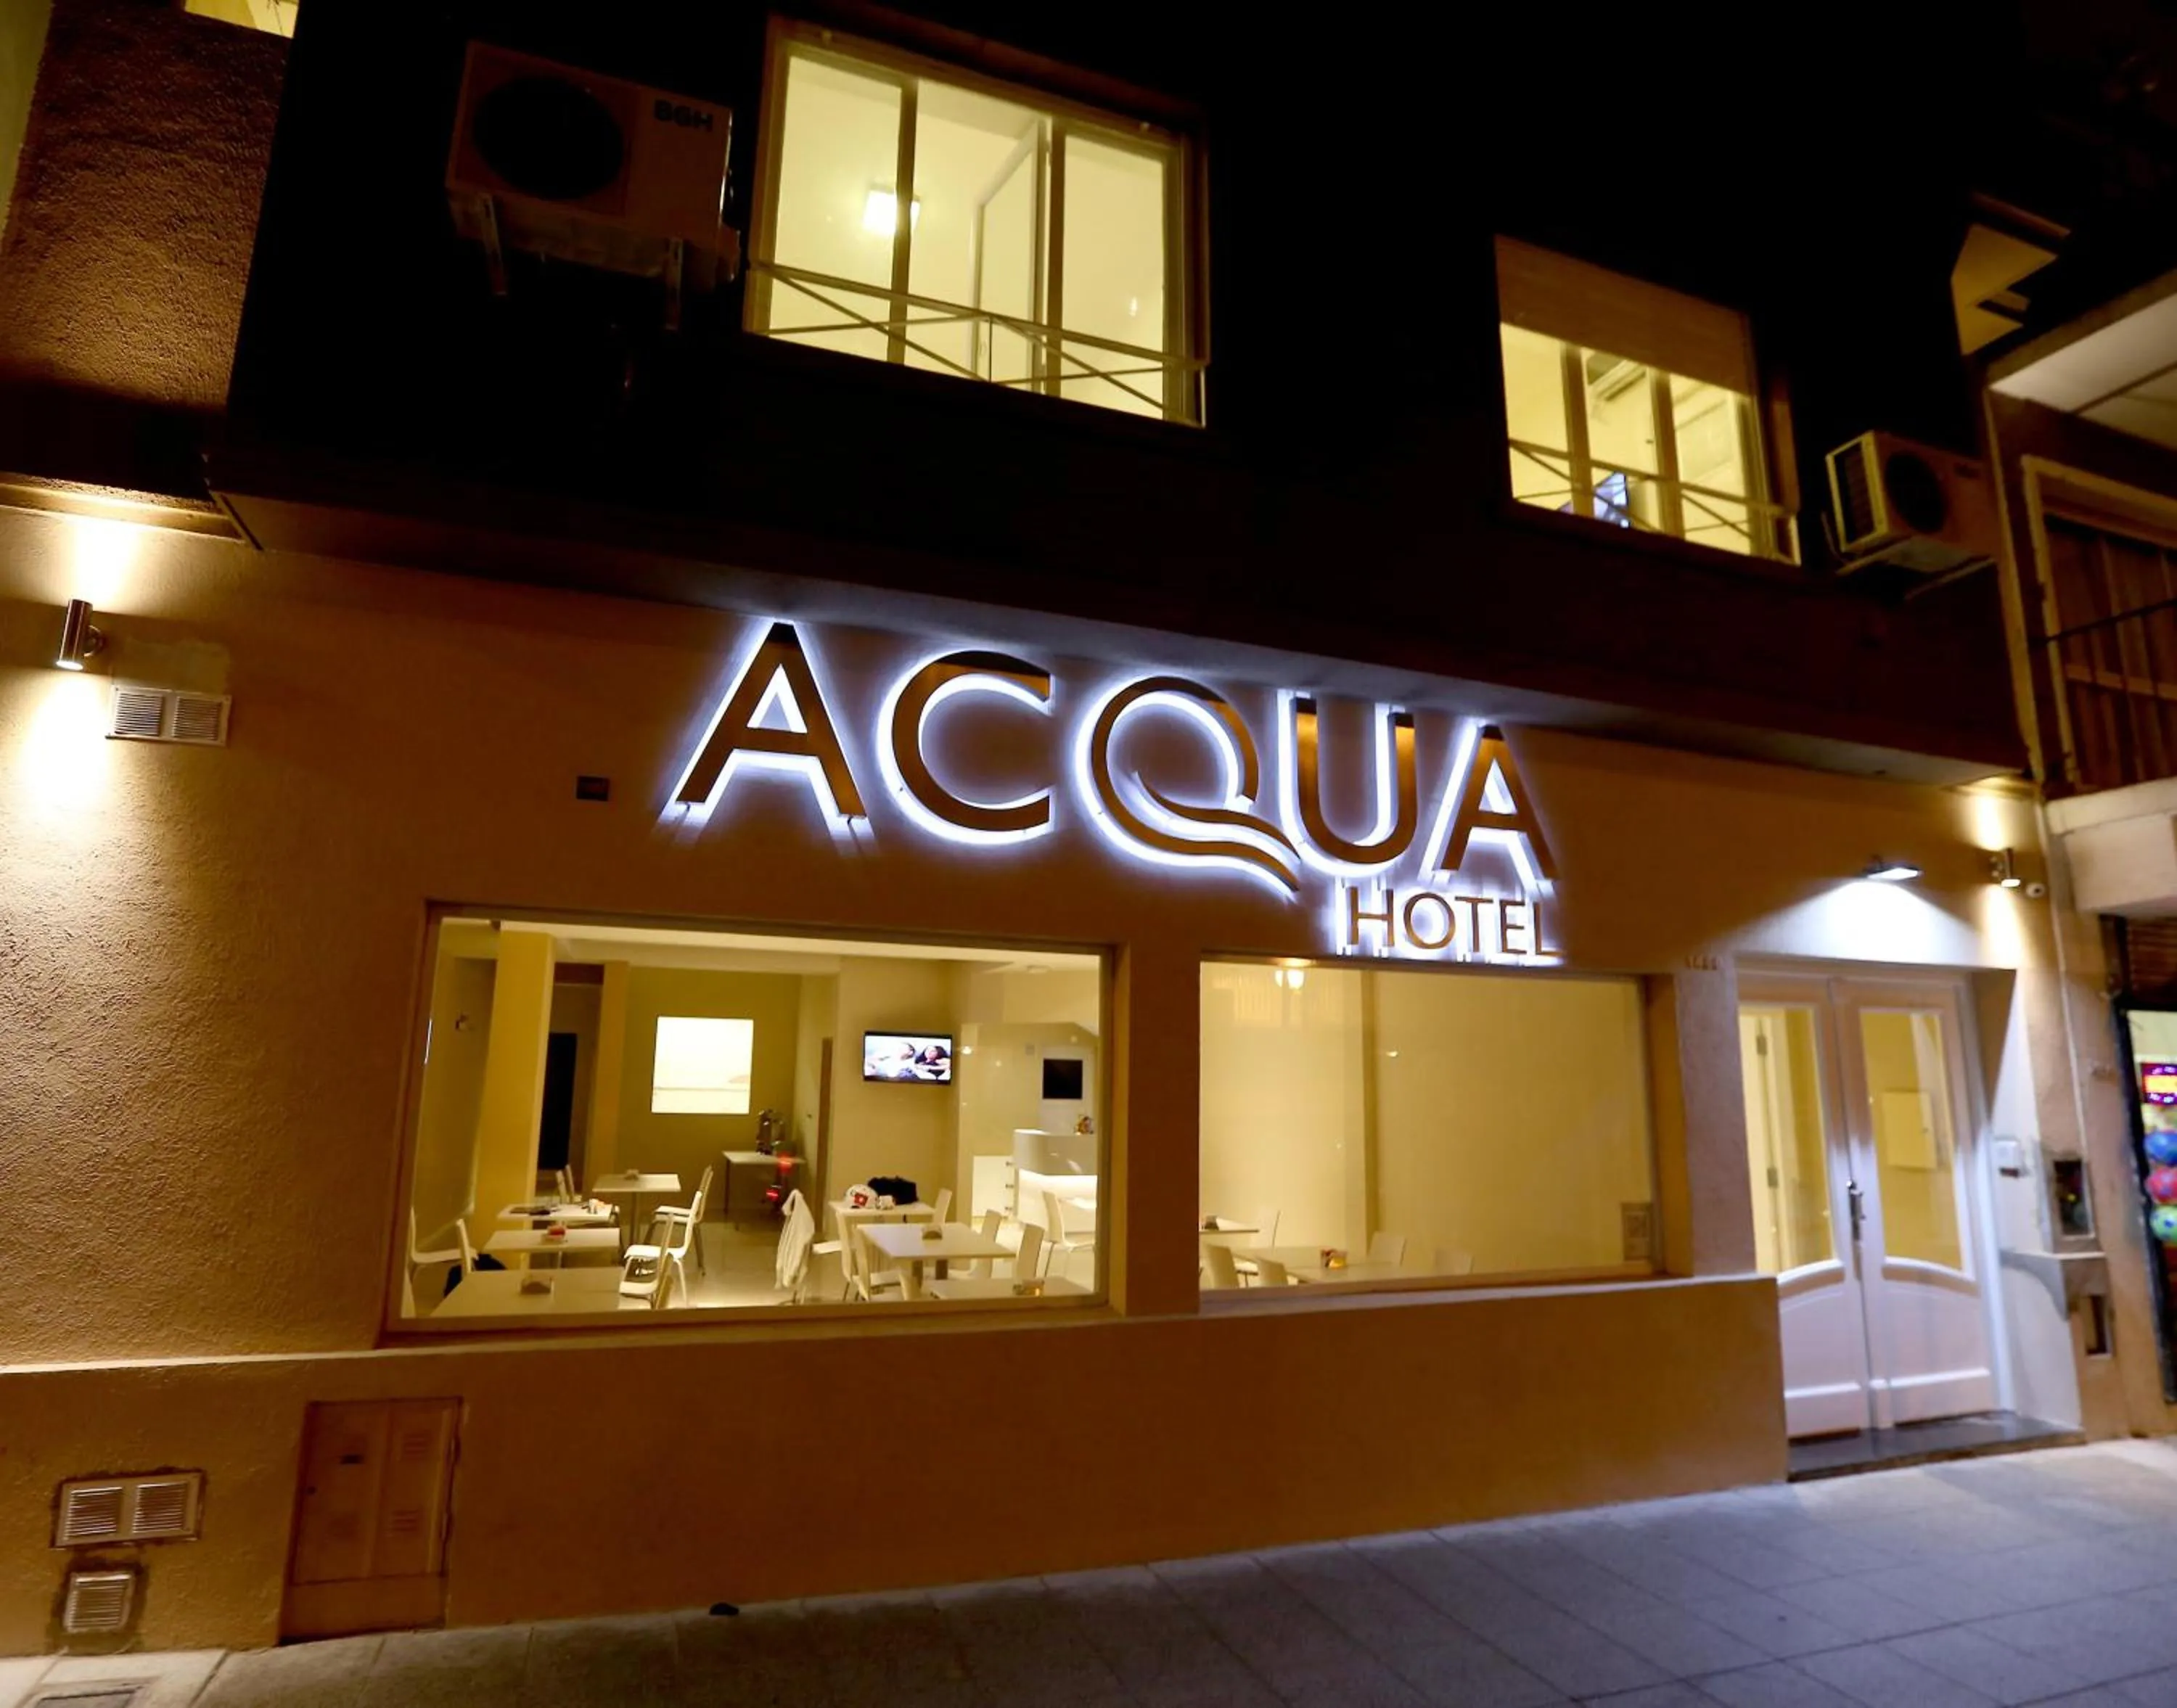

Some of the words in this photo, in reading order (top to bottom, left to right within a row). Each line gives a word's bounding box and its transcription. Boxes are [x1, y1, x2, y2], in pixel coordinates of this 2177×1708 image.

[654, 99, 713, 132] BGH
[674, 622, 1560, 892] ACQUA
[1349, 886, 1563, 956] HOTEL
